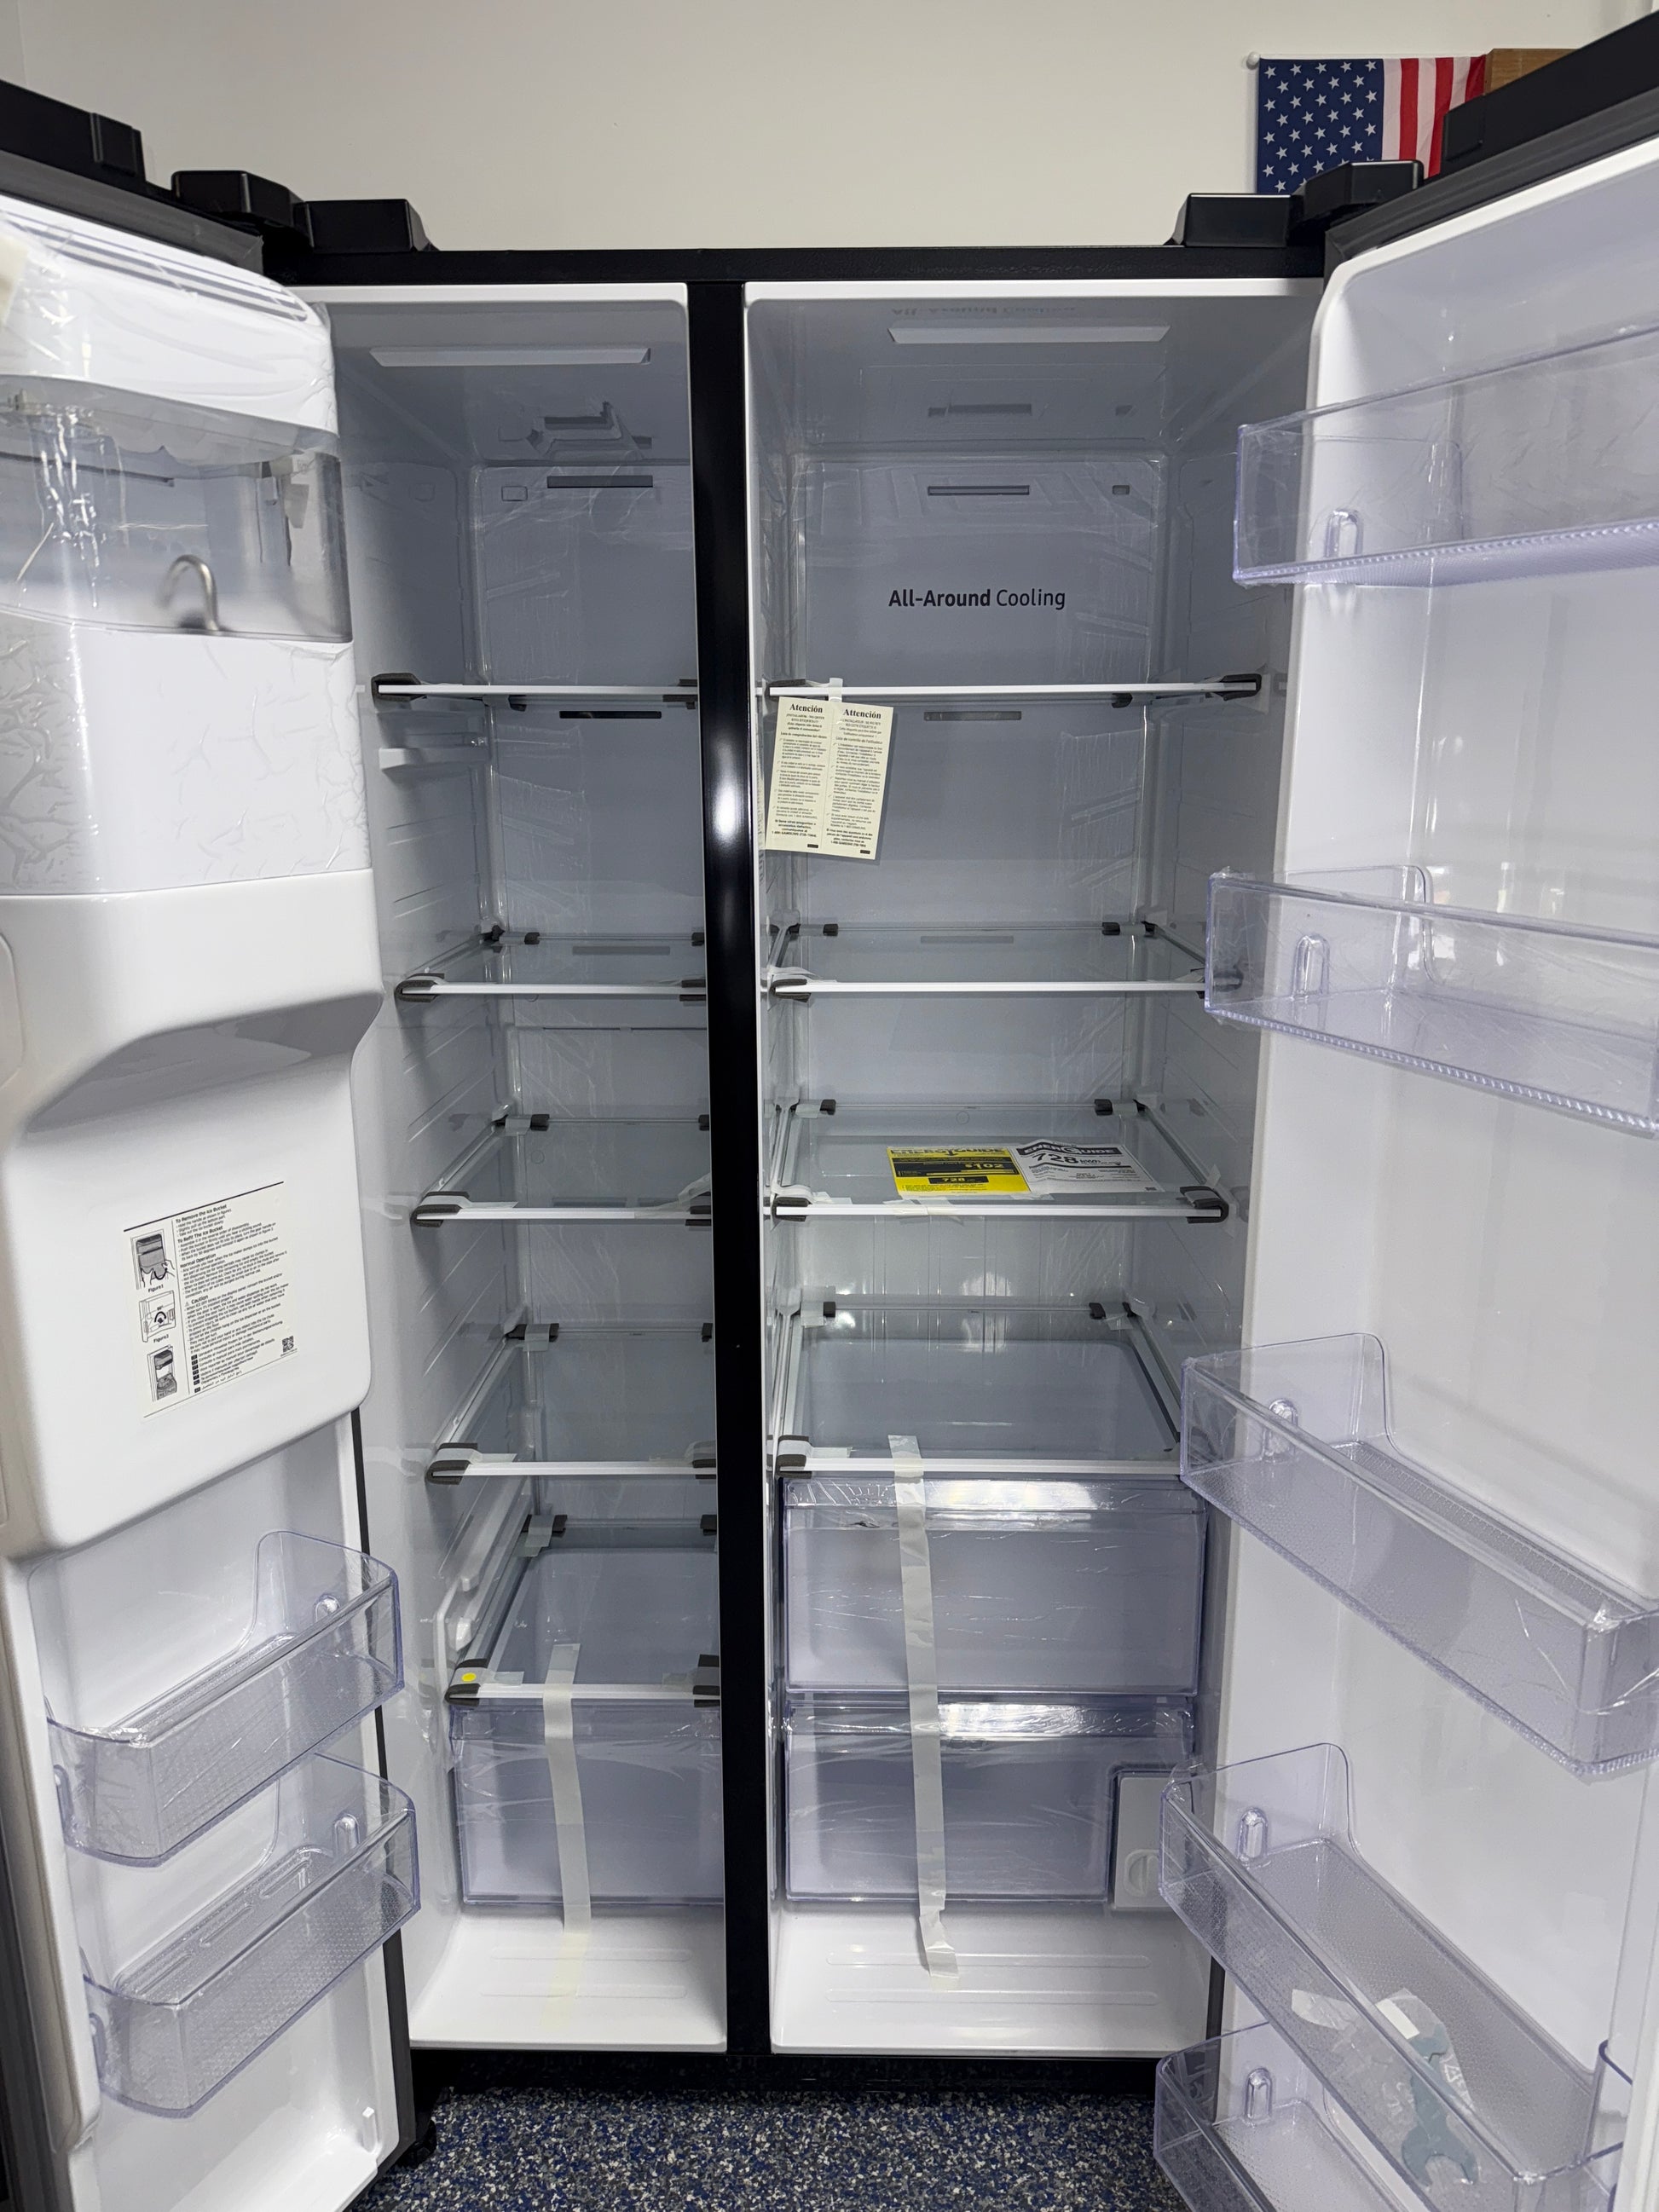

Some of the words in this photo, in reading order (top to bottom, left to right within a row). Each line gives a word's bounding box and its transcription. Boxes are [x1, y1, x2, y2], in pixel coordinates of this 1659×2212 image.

[888, 589, 991, 607] All-Around
[996, 588, 1066, 609] Cooling
[789, 703, 823, 713] Atención
[843, 708, 882, 719] Attención
[1032, 1153, 1078, 1164] 728
[182, 1213, 198, 1222] Remove
[181, 1260, 195, 1268] Normal
[196, 1253, 217, 1263] Operation
[148, 1284, 164, 1293] Figure1
[192, 1295, 208, 1303] Caution
[153, 1334, 169, 1344] Figure2
